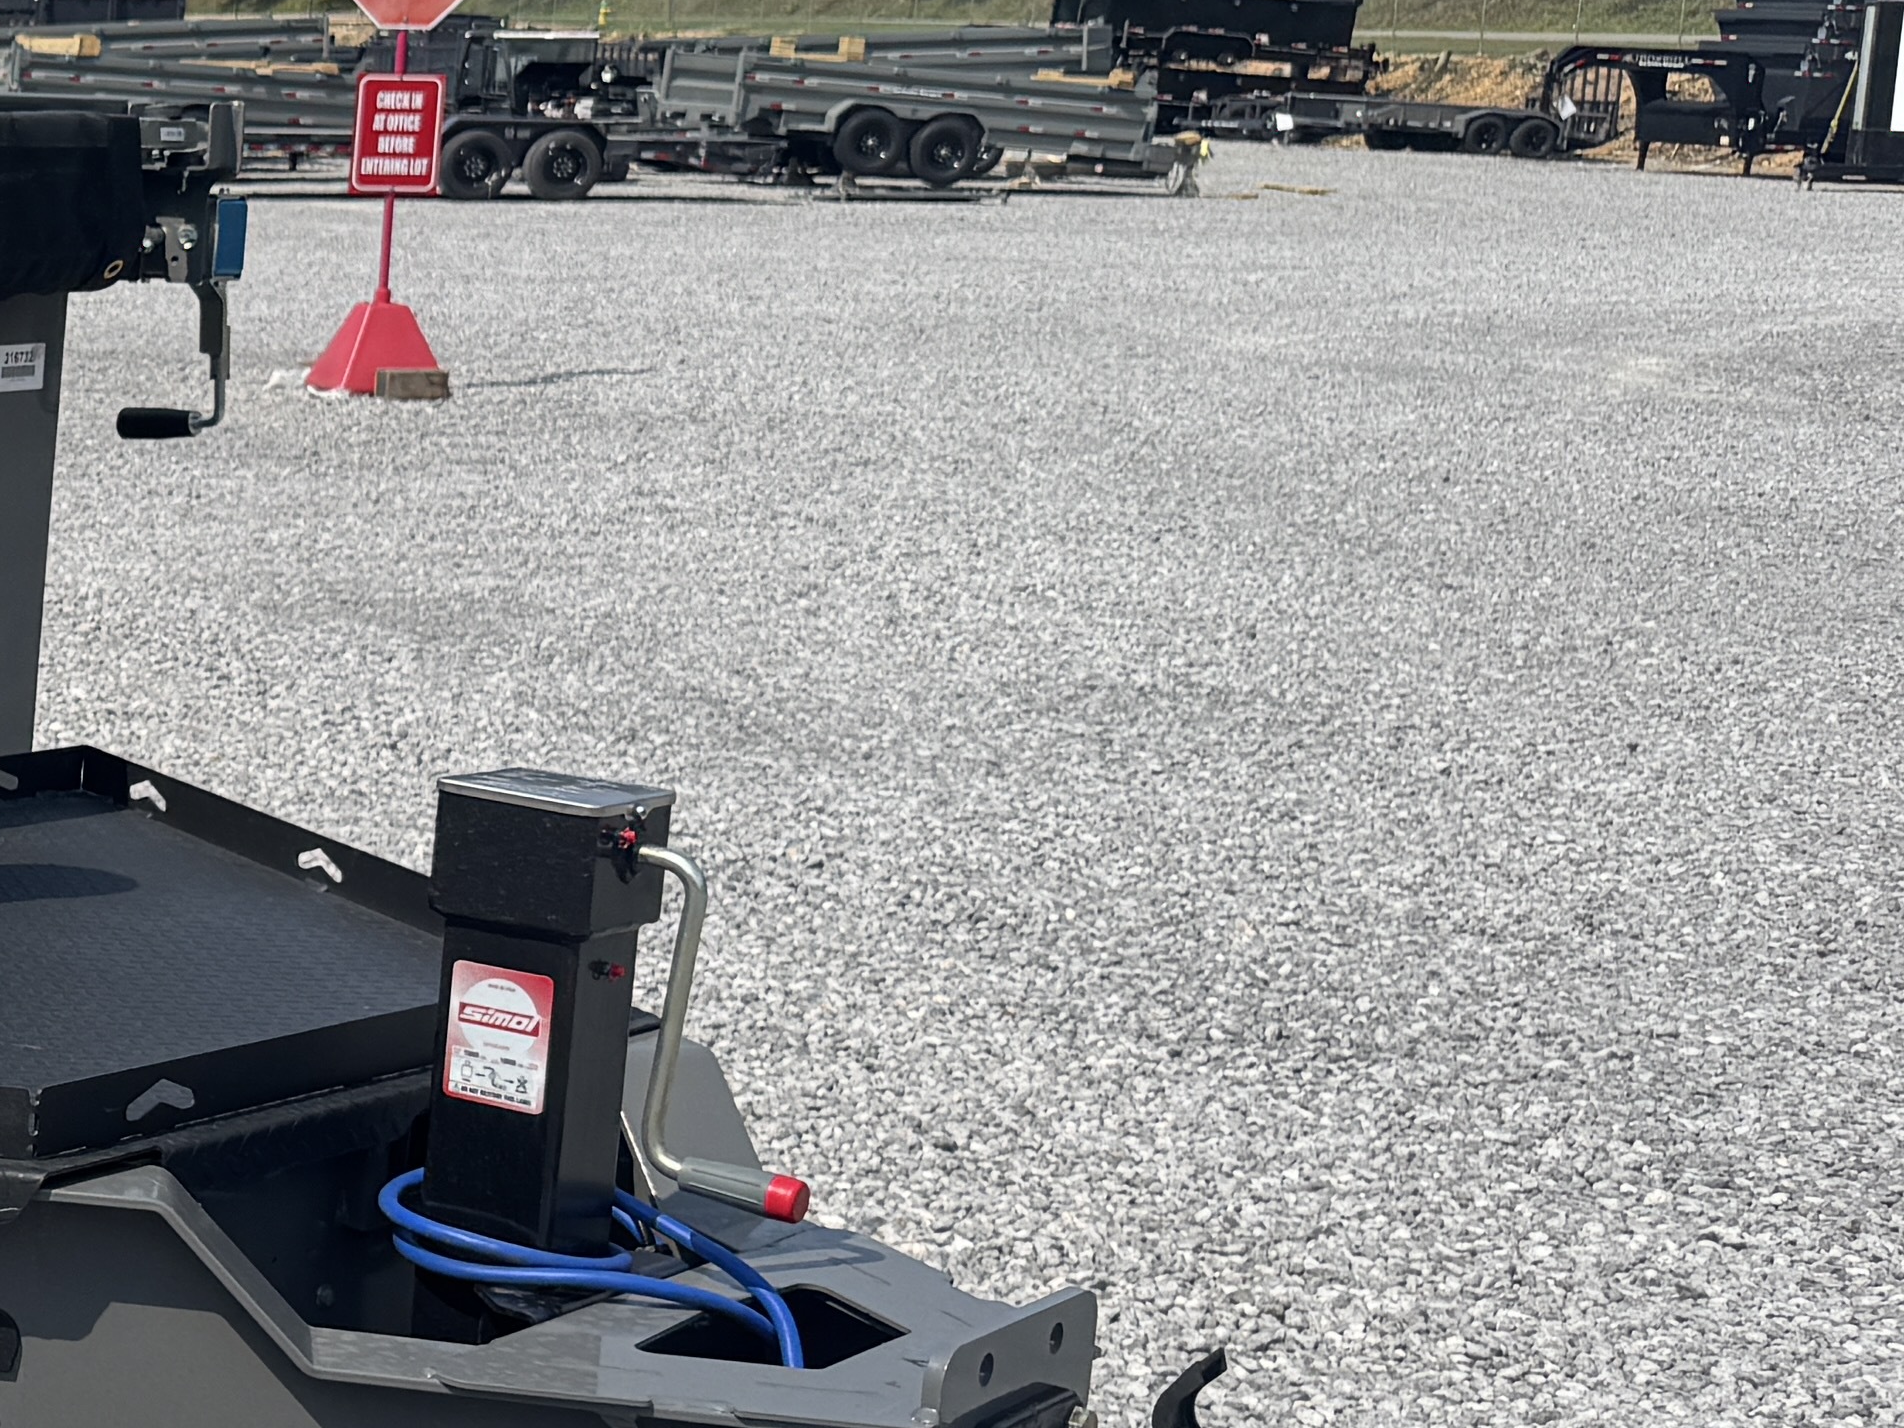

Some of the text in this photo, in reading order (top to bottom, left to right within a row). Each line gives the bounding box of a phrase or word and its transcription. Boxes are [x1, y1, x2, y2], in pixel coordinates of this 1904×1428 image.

[376, 90, 424, 110] CHECK IN
[372, 113, 421, 132] AT OFFICE
[377, 135, 416, 154] BEFORE
[361, 157, 428, 176] ENTERING LOT
